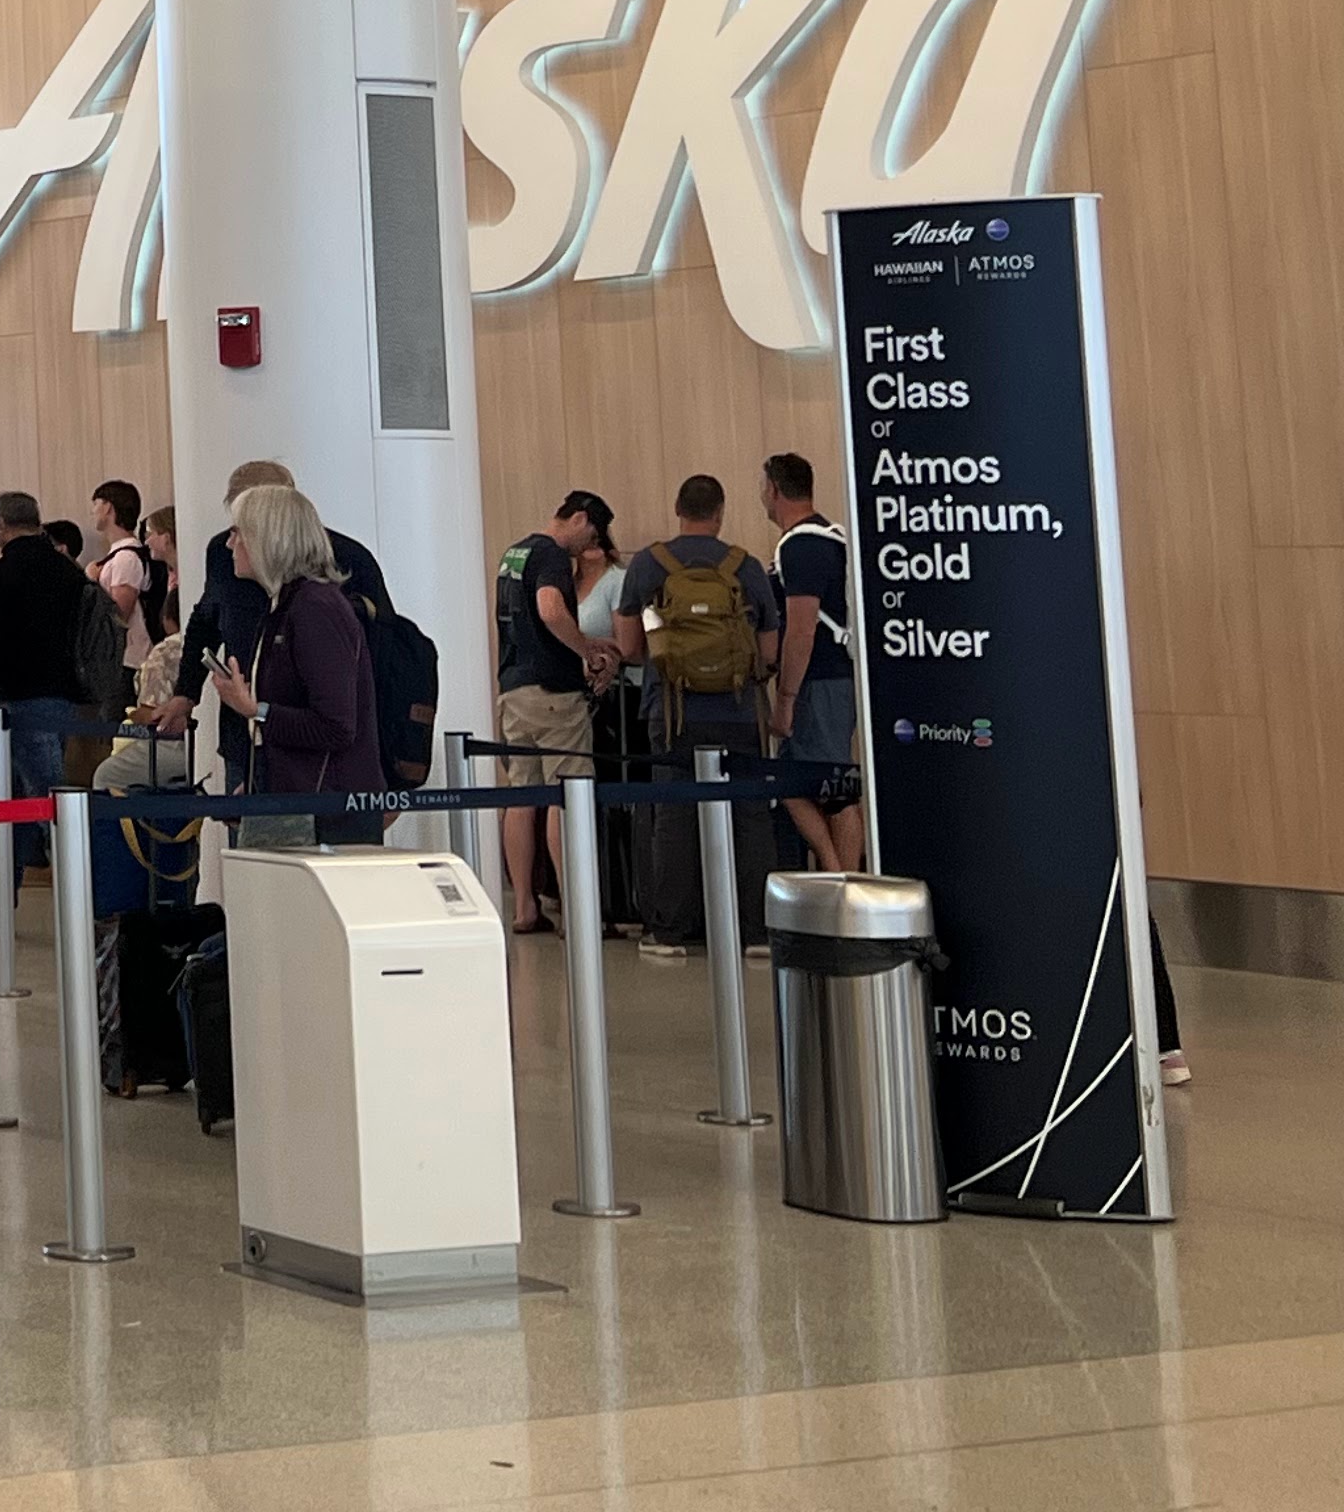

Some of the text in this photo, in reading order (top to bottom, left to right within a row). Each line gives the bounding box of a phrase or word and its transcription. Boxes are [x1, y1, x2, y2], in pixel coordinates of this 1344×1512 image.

[892, 220, 975, 246] Alaska
[874, 254, 1035, 277] HAWAIIAN ATMOS
[864, 326, 946, 362] First
[867, 373, 970, 410] Class
[870, 420, 894, 438] or
[871, 449, 1000, 486] Atmos
[876, 495, 1064, 539] Platinum,
[878, 543, 971, 581] Gold
[882, 590, 905, 608] or
[883, 619, 990, 658] Silver
[919, 724, 971, 744] Priority
[345, 791, 410, 811] ATMOS
[934, 1006, 1032, 1040] TMOS
